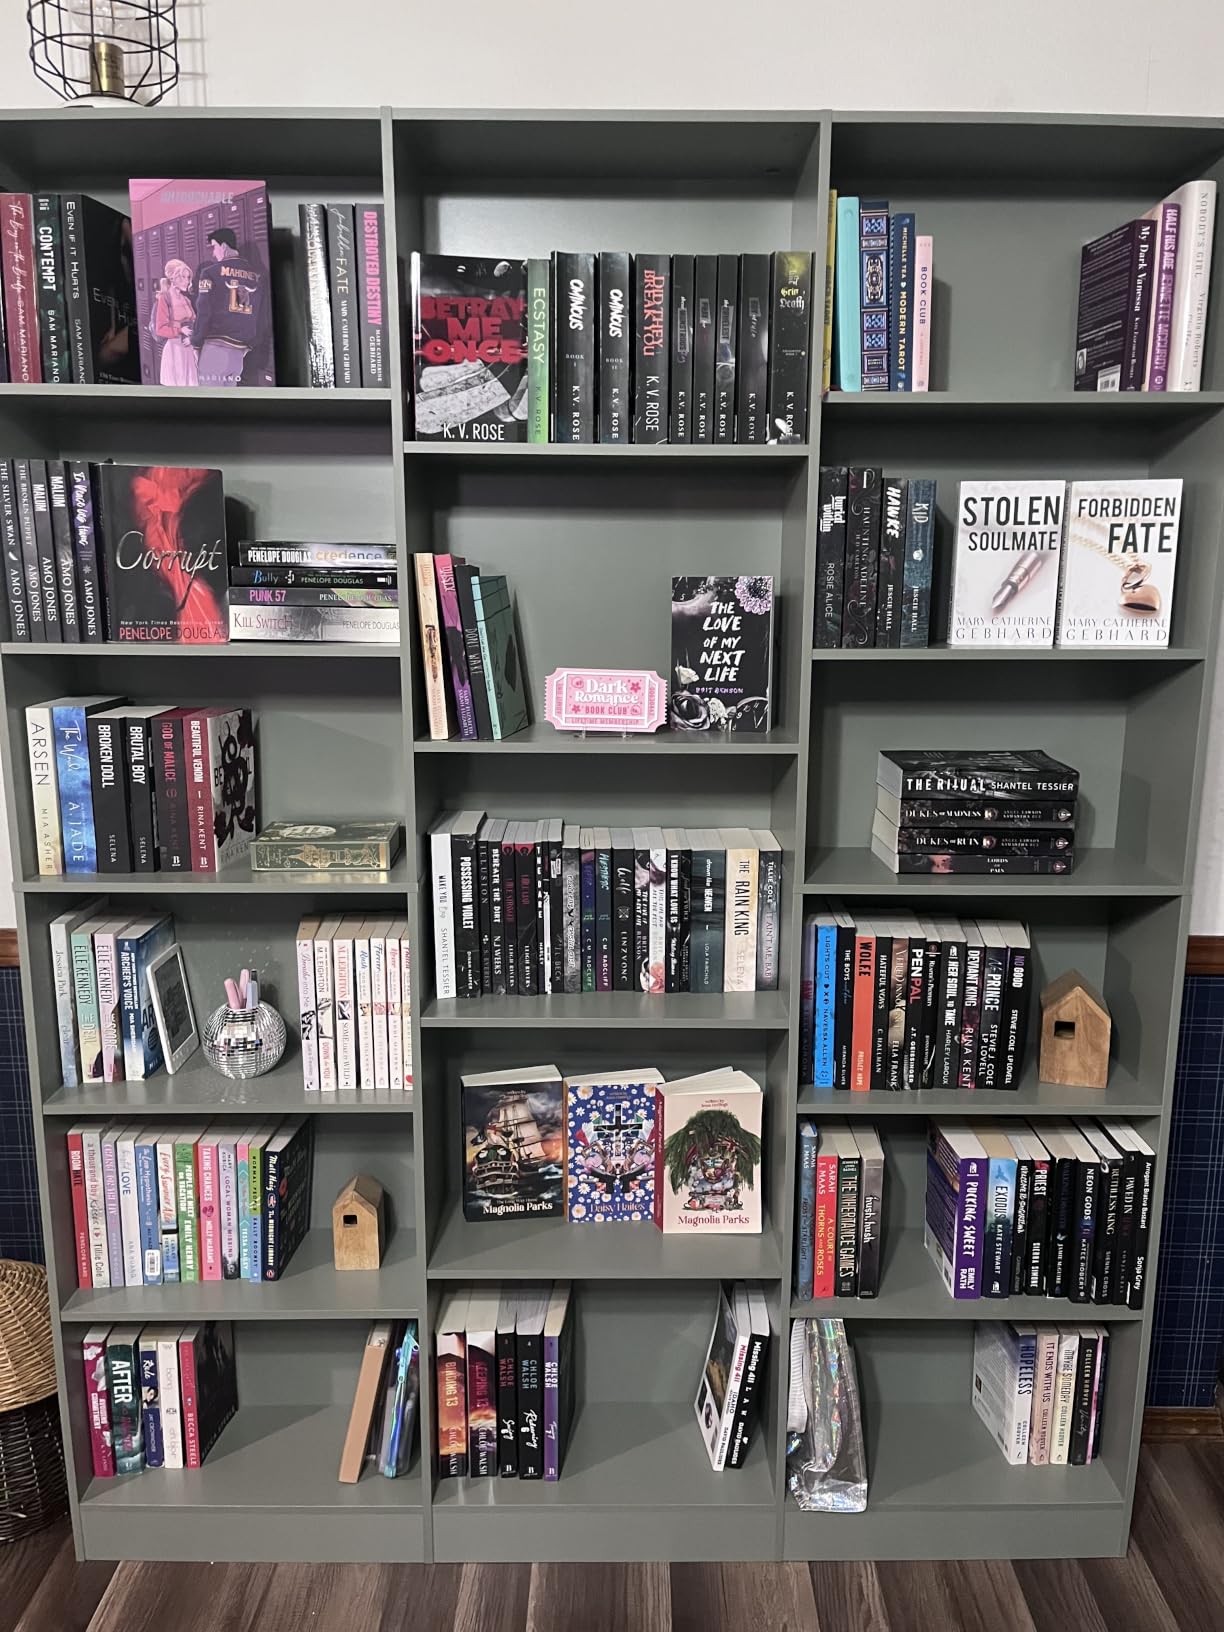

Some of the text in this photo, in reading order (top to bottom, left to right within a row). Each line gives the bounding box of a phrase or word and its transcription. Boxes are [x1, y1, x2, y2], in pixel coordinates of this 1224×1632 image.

[1139, 225, 1150, 241] My
[39, 227, 56, 291] CONTEMPT
[364, 211, 382, 325] DESTROYED DESTINY
[1138, 244, 1150, 269] Dark
[336, 258, 349, 294] FATE
[1134, 272, 1147, 312] Vanessa
[420, 295, 525, 319] BETRAY
[569, 278, 587, 331] OMINOUS
[609, 288, 628, 338] OMINOUS
[919, 300, 927, 325] CLUB
[447, 317, 502, 342] ME
[533, 287, 546, 364] ECSTASY
[898, 291, 907, 371] MODERN TAROT
[47, 310, 60, 383] SAM MARIANO
[419, 339, 523, 364] ONCE
[32, 484, 47, 512] MALUM
[51, 476, 66, 508] MALUM
[1078, 497, 1176, 518] FORBIDDEN
[886, 486, 902, 539] HAWKE
[963, 496, 1061, 526] STOLEN
[968, 531, 1058, 551] SOULMATE
[1108, 522, 1174, 553] FATE
[116, 530, 223, 579] Corrupt
[28, 564, 42, 622] AMO JONES
[42, 557, 57, 622] AMO JONES
[60, 559, 76, 626] AMO JONES
[253, 570, 279, 584] Bully
[825, 562, 835, 618] ROSIE ALICE
[11, 568, 26, 636] AMO JONES
[84, 579, 96, 636] AMO JONES
[249, 589, 287, 602] PUNK 57
[710, 601, 735, 614] THE
[702, 615, 742, 632] LOVE
[955, 628, 1052, 640] GEBHARD
[957, 616, 1051, 627] MARY CATHERINE
[1066, 629, 1167, 641] GEBHARD
[1067, 618, 1167, 628] MARY CATHERINE
[700, 650, 746, 666] NEXT
[703, 636, 741, 648] OF MY
[586, 679, 629, 694] Dark
[704, 666, 740, 682] LIFE
[574, 690, 639, 706] Romance
[585, 705, 628, 715] BOOK CLUB
[31, 722, 50, 786] ARSEN
[98, 724, 115, 789] BROKEN DOLL
[130, 726, 146, 785] BRUTAL BOY
[907, 778, 1074, 792] THE RITUAL SHANTEL TESSIER
[109, 834, 117, 863] SELENA
[480, 845, 488, 904] ILLUSION
[460, 856, 474, 930] POSSESSING VIOLET
[734, 860, 750, 936] THE RAIN KING
[441, 928, 450, 964] SHANTEL
[74, 945, 91, 1006] ELLE KENNEDY
[97, 945, 113, 1005] ELLE KENNEDY
[121, 951, 134, 1010] ARCHER'S VOICE
[338, 957, 347, 998] LEIGHTON
[910, 948, 923, 1004] PEN PAL
[964, 950, 980, 1007] DEVIANT KING
[890, 1040, 899, 1087] ELLA FRANK
[961, 1027, 974, 1088] RINA KENT
[121, 1171, 132, 1195] LOVE
[144, 1172, 152, 1206] Hypothesis
[828, 1163, 837, 1193] SARAH
[1033, 1169, 1048, 1197] PRIEST
[1083, 1167, 1095, 1221] NEON GODS
[483, 1201, 553, 1216] Magnolia Parks
[590, 1201, 646, 1216] Daisy Haites
[994, 1185, 1009, 1221] EXODUS
[1105, 1168, 1120, 1236] RUTHLESS KING
[678, 1214, 750, 1227] Magnolia Parks
[840, 1176, 857, 1278] THE INHERITANCE GAMES
[962, 1182, 978, 1257] PUCKING SWEET
[184, 1220, 194, 1271] EMILY HENRY
[816, 1205, 826, 1276] THORNS ROSES
[993, 1224, 1003, 1274] KATE STEWART
[959, 1268, 968, 1289] RATH
[967, 1268, 976, 1290] EMILY
[1133, 1256, 1145, 1291] Sonja Grey
[143, 1359, 156, 1380] Rule
[499, 1358, 507, 1387] WALSH
[506, 1358, 514, 1387] CHLOE
[521, 1359, 530, 1390] WALSH
[529, 1359, 538, 1390] CHLOE
[544, 1361, 552, 1388] WALSH
[550, 1361, 558, 1388] CHLOE
[1017, 1344, 1035, 1395] HOPELESS
[1045, 1351, 1054, 1371] ENDS
[1081, 1349, 1093, 1406] COLLEEN HOOVER
[111, 1360, 133, 1404] AFTER
[1042, 1391, 1051, 1403] US
[1043, 1371, 1053, 1391] WITH
[187, 1412, 198, 1466] BECCA STEELE
